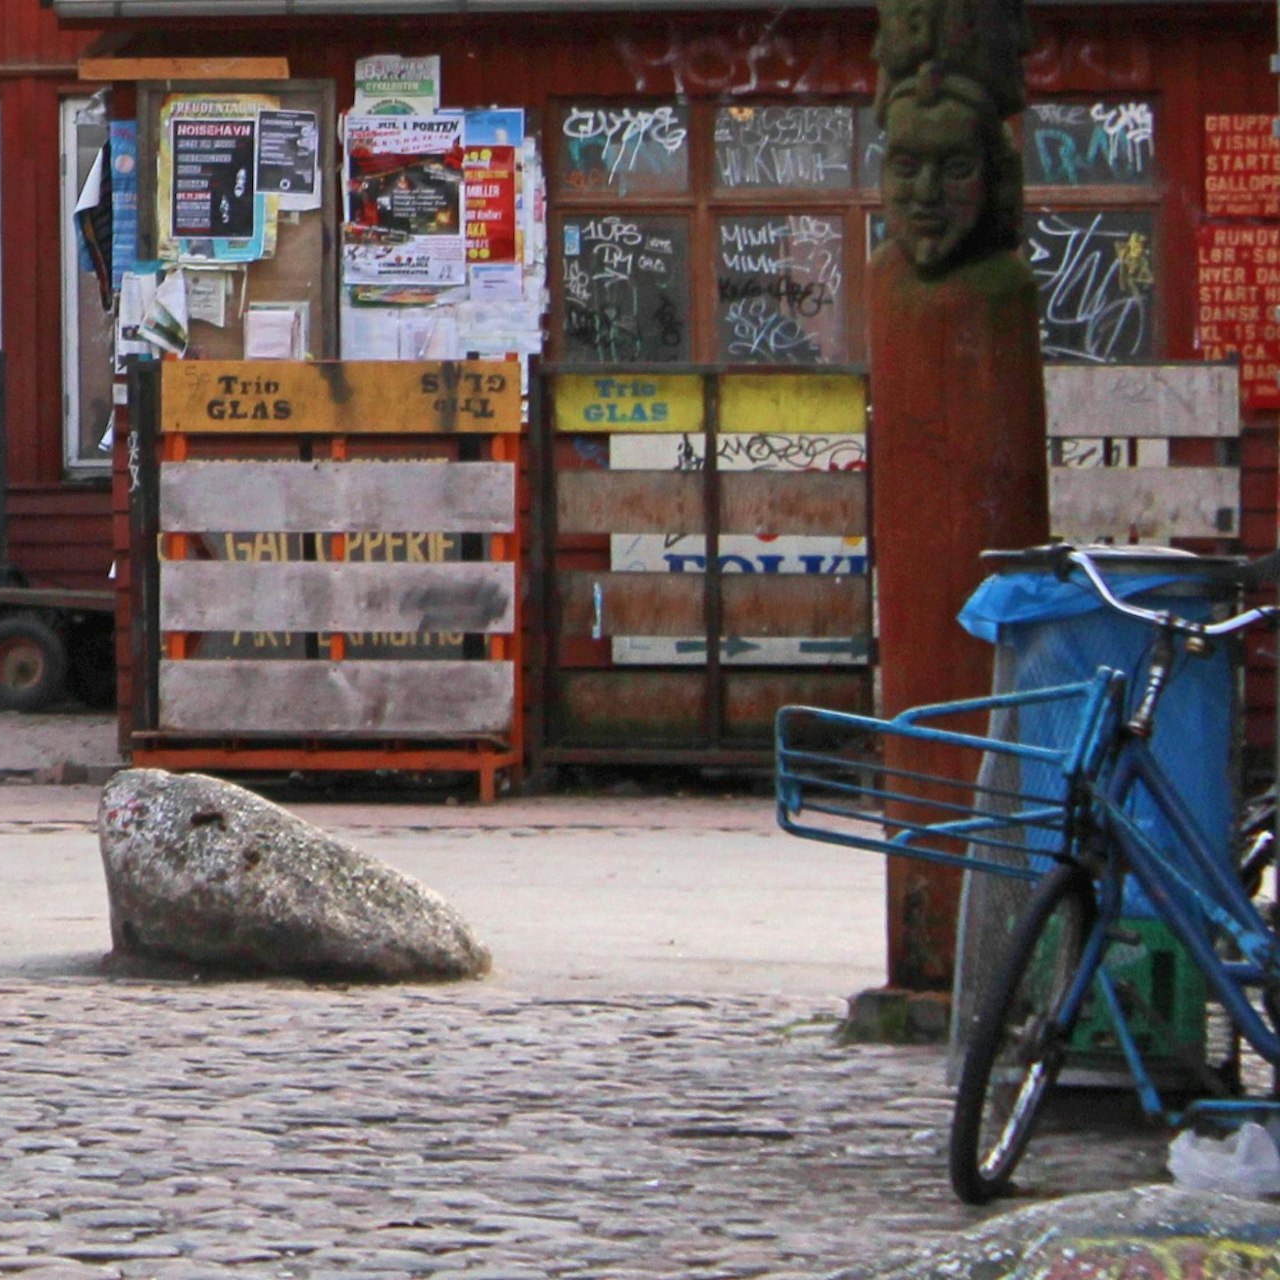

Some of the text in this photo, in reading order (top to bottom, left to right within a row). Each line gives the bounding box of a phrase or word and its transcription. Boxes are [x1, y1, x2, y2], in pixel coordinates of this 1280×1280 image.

[177, 124, 251, 136] NOISEHAVN
[412, 120, 459, 133] PORTEN
[1199, 286, 1258, 303] START
[217, 375, 280, 395] Trio
[595, 380, 657, 399] Trio
[206, 399, 292, 420] GLAS
[583, 402, 669, 422] GLAS
